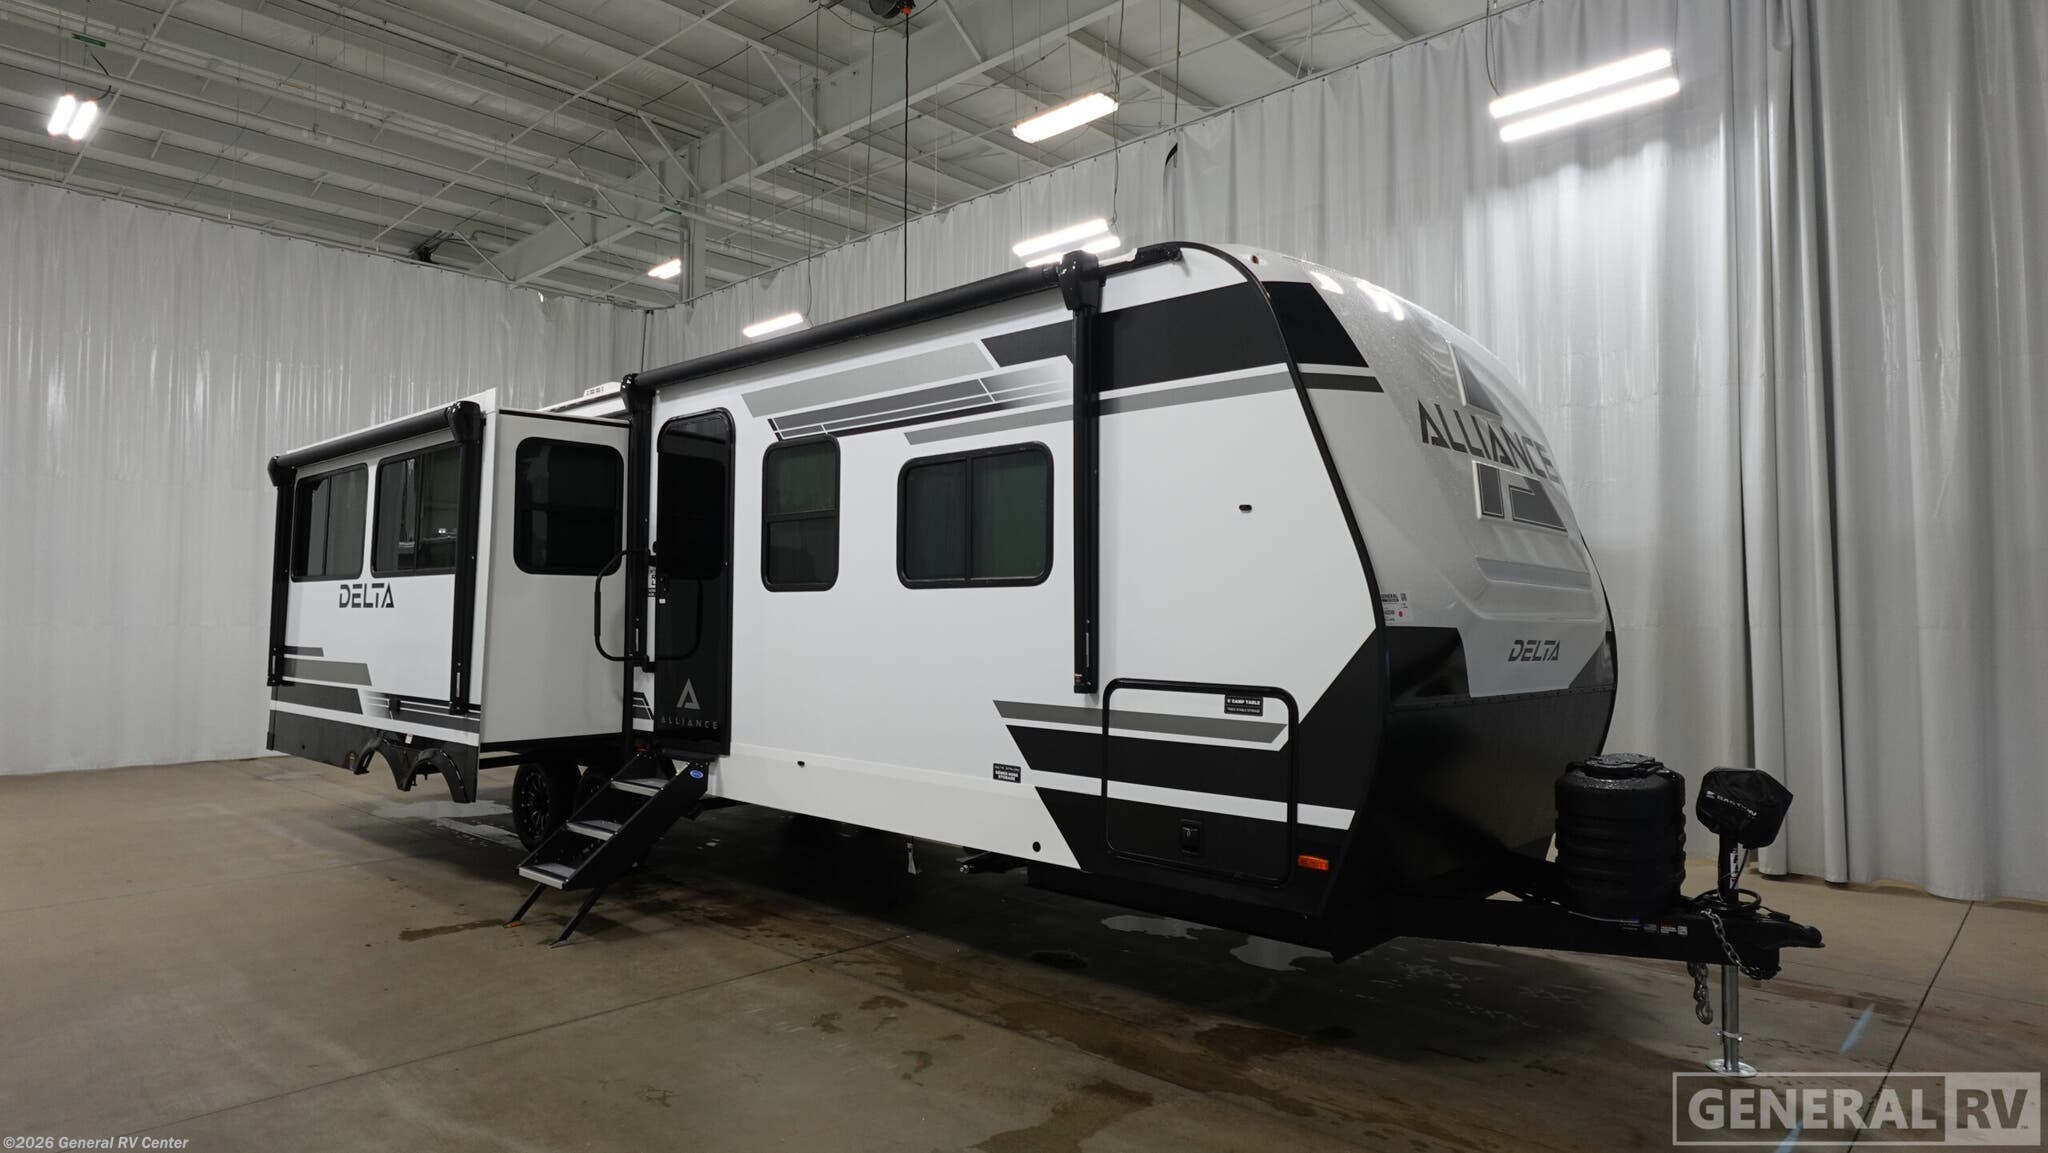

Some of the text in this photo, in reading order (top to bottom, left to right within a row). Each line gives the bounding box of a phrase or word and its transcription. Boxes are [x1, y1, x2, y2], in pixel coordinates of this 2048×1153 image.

[1418, 400, 1561, 484] ALLIANCE
[339, 582, 394, 608] DELTA
[1508, 640, 1560, 661] DELTA
[660, 715, 719, 730] ALLIANCE
